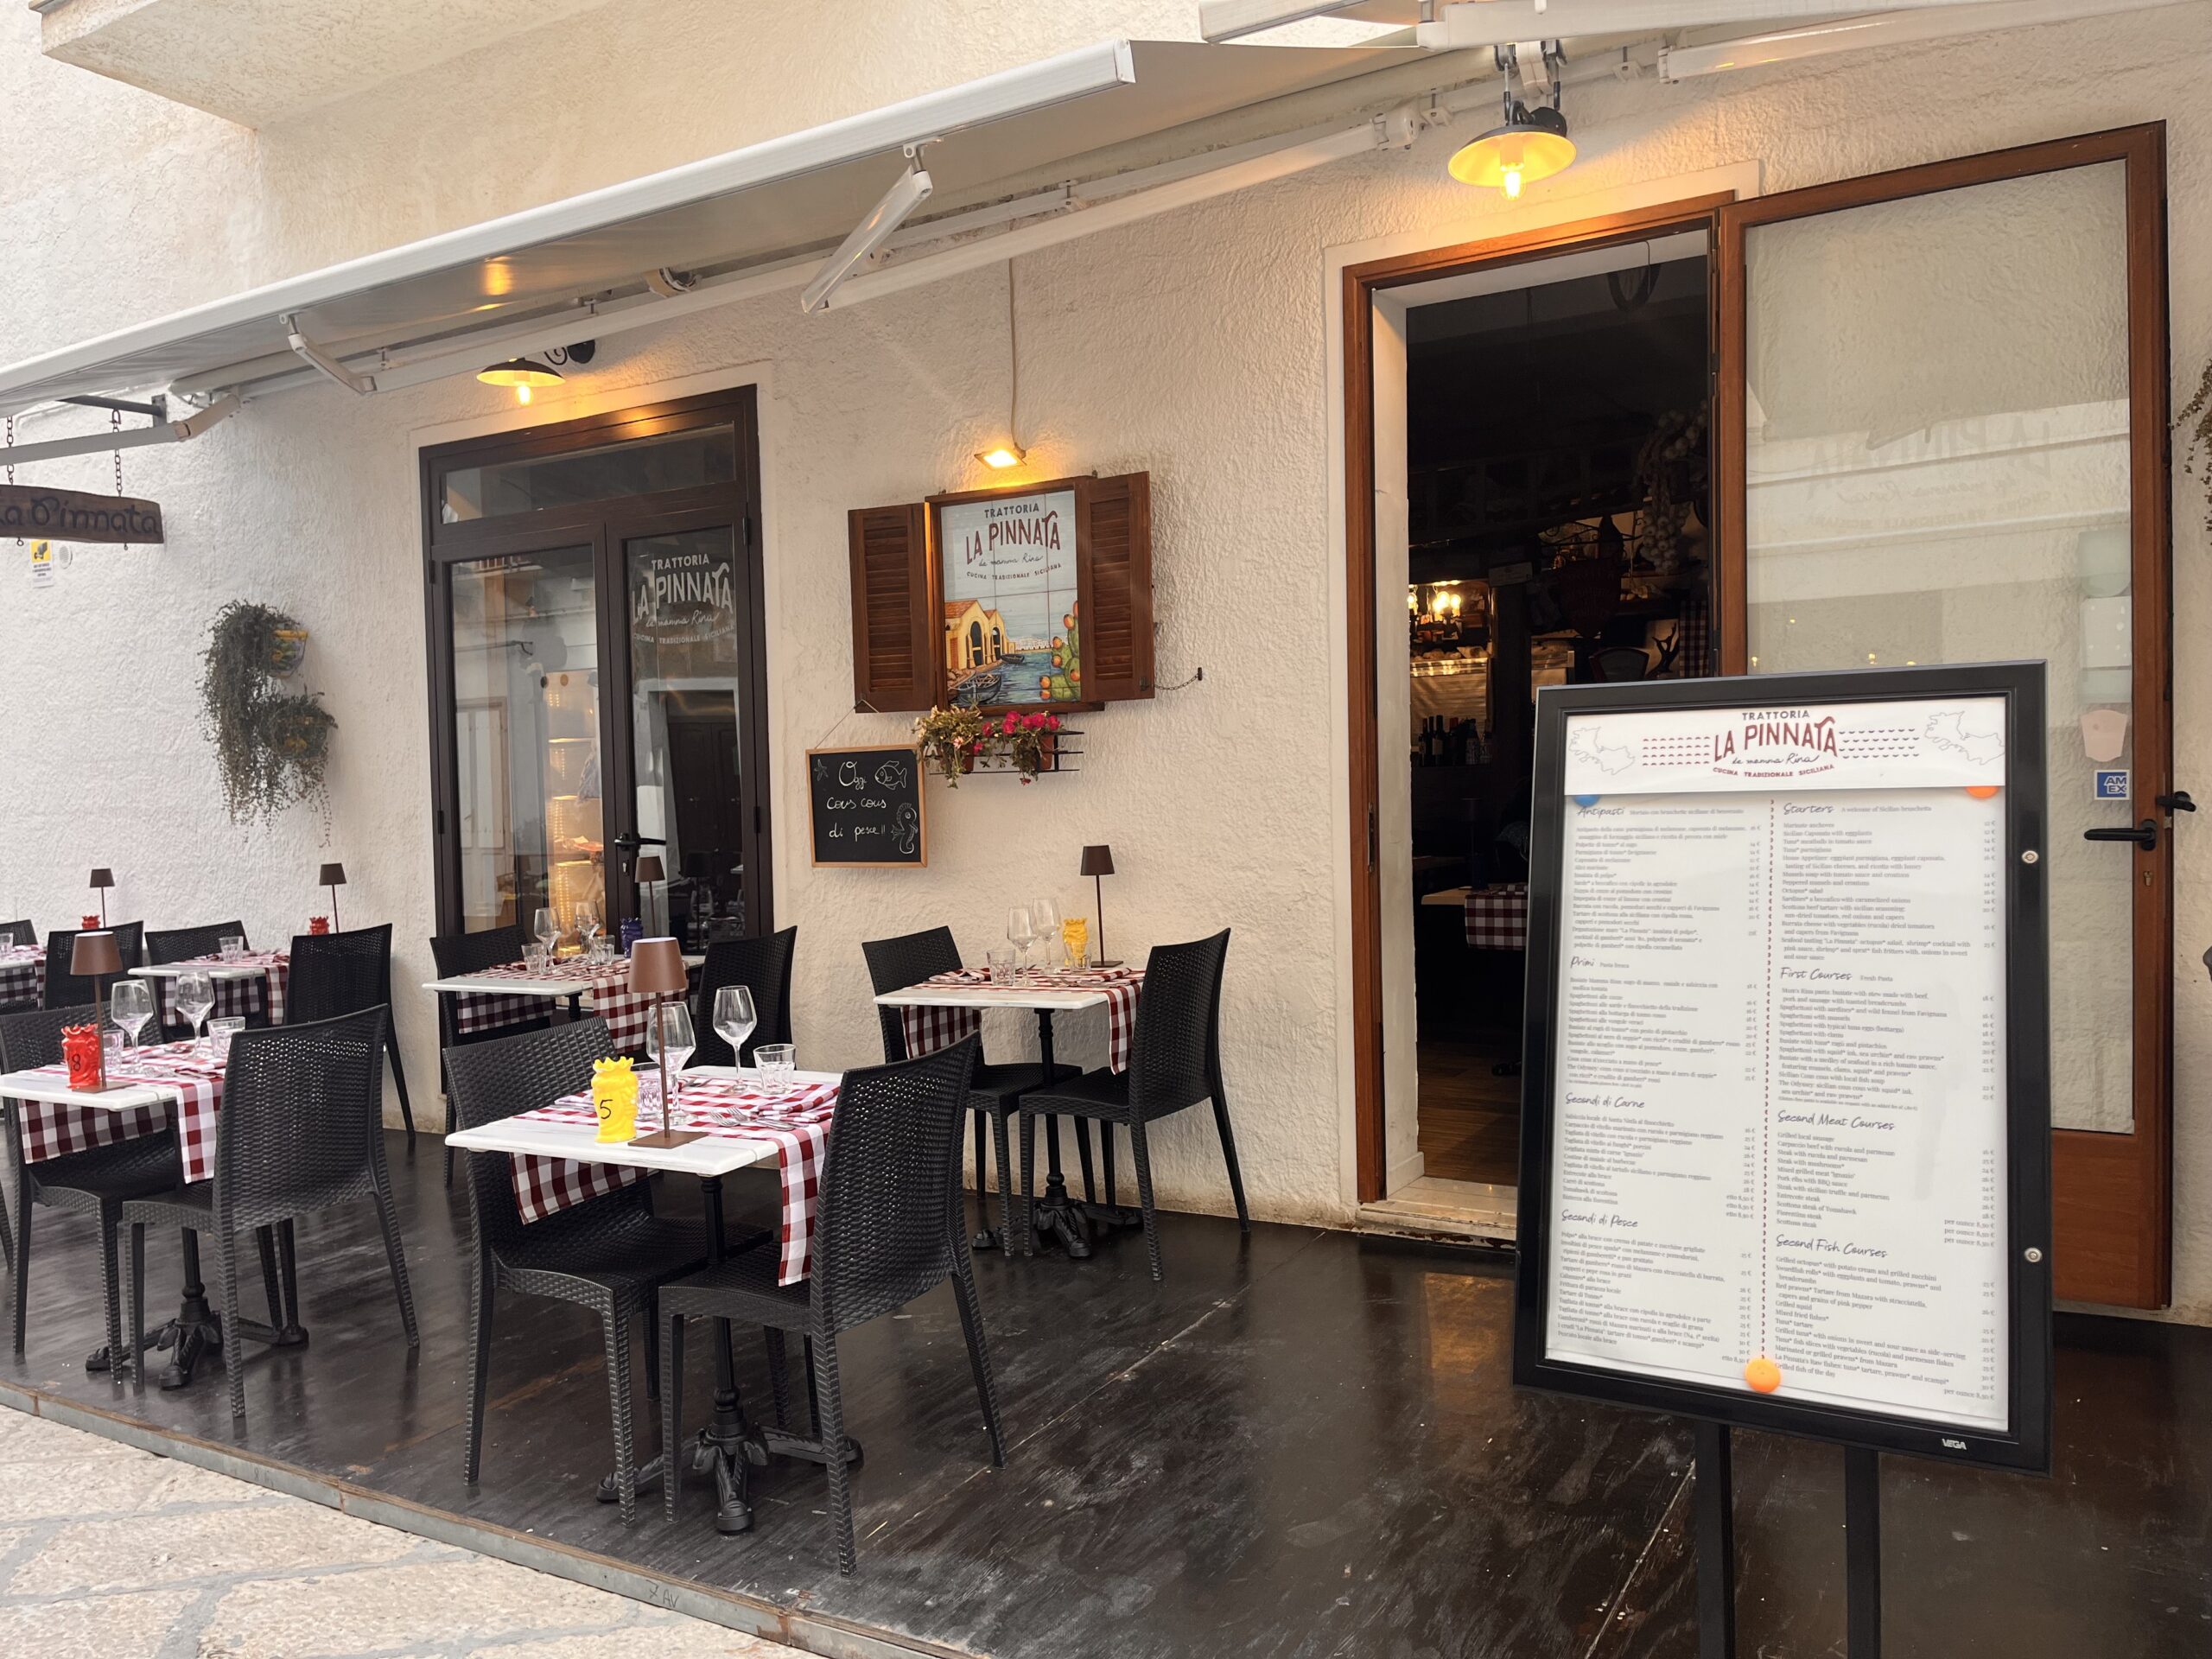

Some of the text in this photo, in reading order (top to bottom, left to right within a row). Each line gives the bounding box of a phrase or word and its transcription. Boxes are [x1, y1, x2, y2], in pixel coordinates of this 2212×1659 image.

[984, 503, 1039, 518] TRATTORIA
[966, 510, 1061, 565] LA PINNATA
[652, 553, 709, 571] TRATTORIA
[1022, 552, 1044, 563] Rina
[967, 563, 1061, 581] CUCINA TRADIZIONALE SICILIANA
[632, 563, 734, 625] LA PINNATA
[690, 609, 720, 625] Rina
[632, 625, 734, 645] CUCINA TRADIZIONALE SICILIANA
[1742, 709, 1810, 721] TRATTORIA
[1714, 716, 1838, 762] LA PINNATA
[1785, 753, 1820, 765] Rina
[1713, 767, 1738, 776] CUCINA
[1798, 764, 1835, 776] SICILIANA
[1577, 806, 1625, 819] Antipasti
[1783, 802, 1834, 815] Starters
[829, 822, 843, 838] di
[1570, 956, 1595, 969] Primi
[1781, 967, 1808, 979] First
[1809, 969, 1853, 980] Courses
[1565, 1091, 1645, 1108] Secondi di Carne
[600, 1098, 613, 1120] 5
[1777, 1109, 1895, 1130] Second Meat Courses
[1561, 1210, 1638, 1228] Secondi di Pesce
[1776, 1234, 1888, 1258] Second Fish Courses
[1942, 1438, 1967, 1451] VEGA
[663, 1588, 679, 1608] AV
